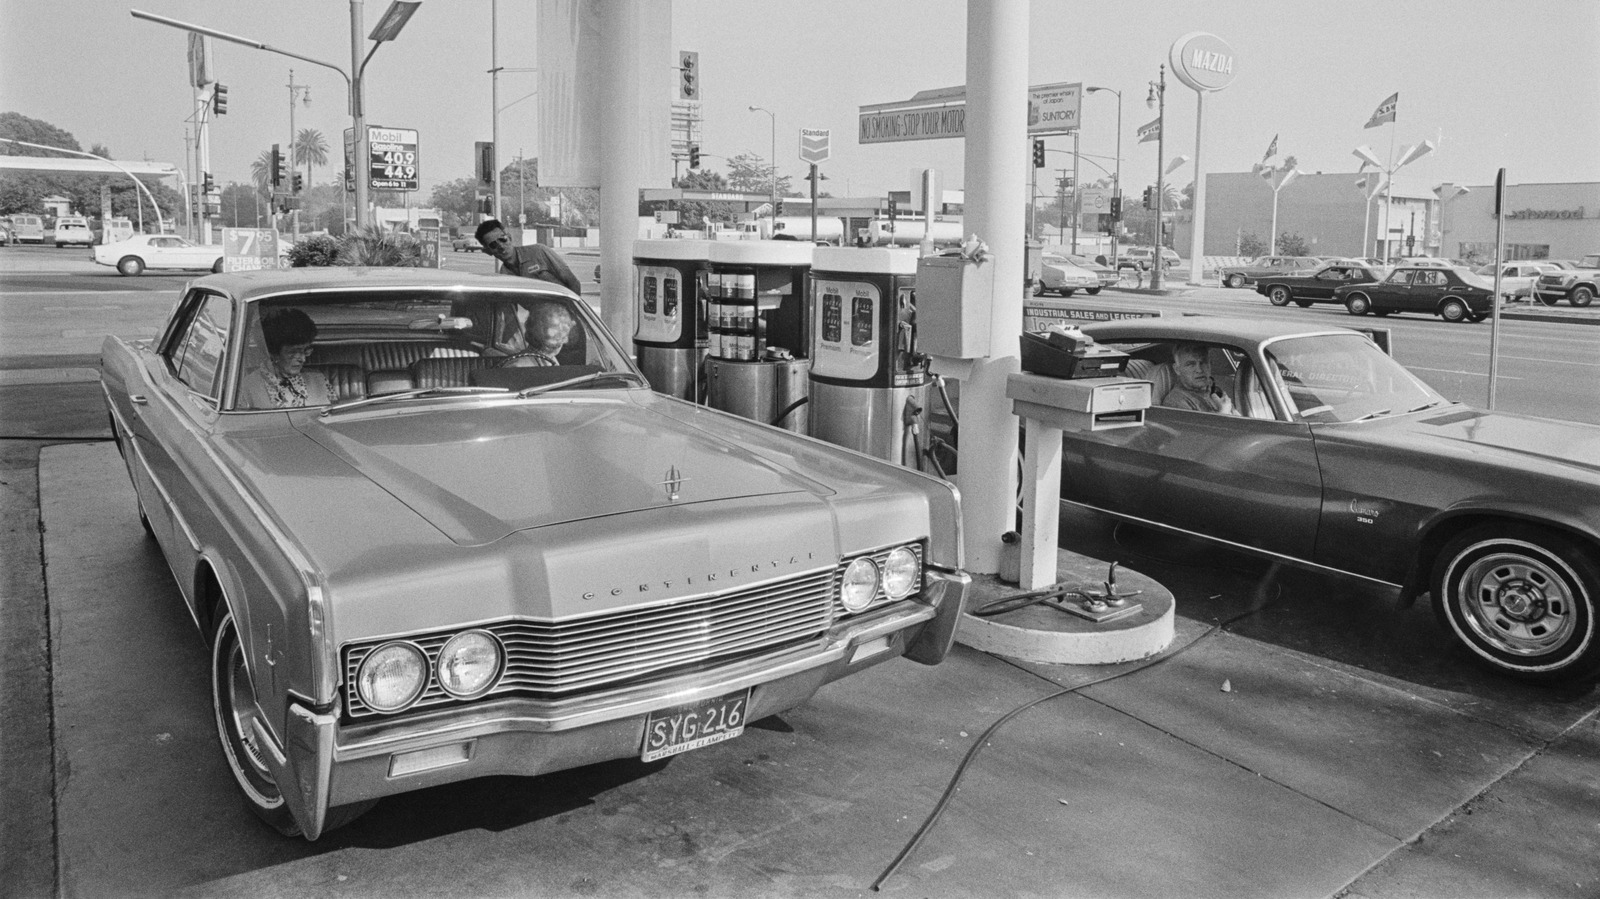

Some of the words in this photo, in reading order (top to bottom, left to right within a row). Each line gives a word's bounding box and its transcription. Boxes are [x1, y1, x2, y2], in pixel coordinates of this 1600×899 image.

[1191, 48, 1233, 75] MAZDA
[1042, 110, 1077, 121] SUNTORY
[861, 116, 871, 140] NO
[921, 111, 939, 135] YOUR
[940, 108, 966, 134] MOTOR
[371, 130, 402, 142] Mobil
[802, 128, 830, 137] Standard
[371, 142, 404, 152] Gasoline
[383, 151, 415, 166] 40.9
[383, 165, 416, 179] 44.9
[371, 181, 389, 189] Open
[711, 192, 744, 201] STANDARD
[227, 256, 253, 265] FILTER
[261, 257, 275, 266] OIL
[1026, 307, 1069, 318] INDUSTRIAL
[1070, 310, 1096, 321] SALES
[1096, 312, 1109, 321] AND
[582, 552, 816, 600] CONTINENTAL
[652, 713, 698, 748] SYG
[702, 701, 742, 735] 216
